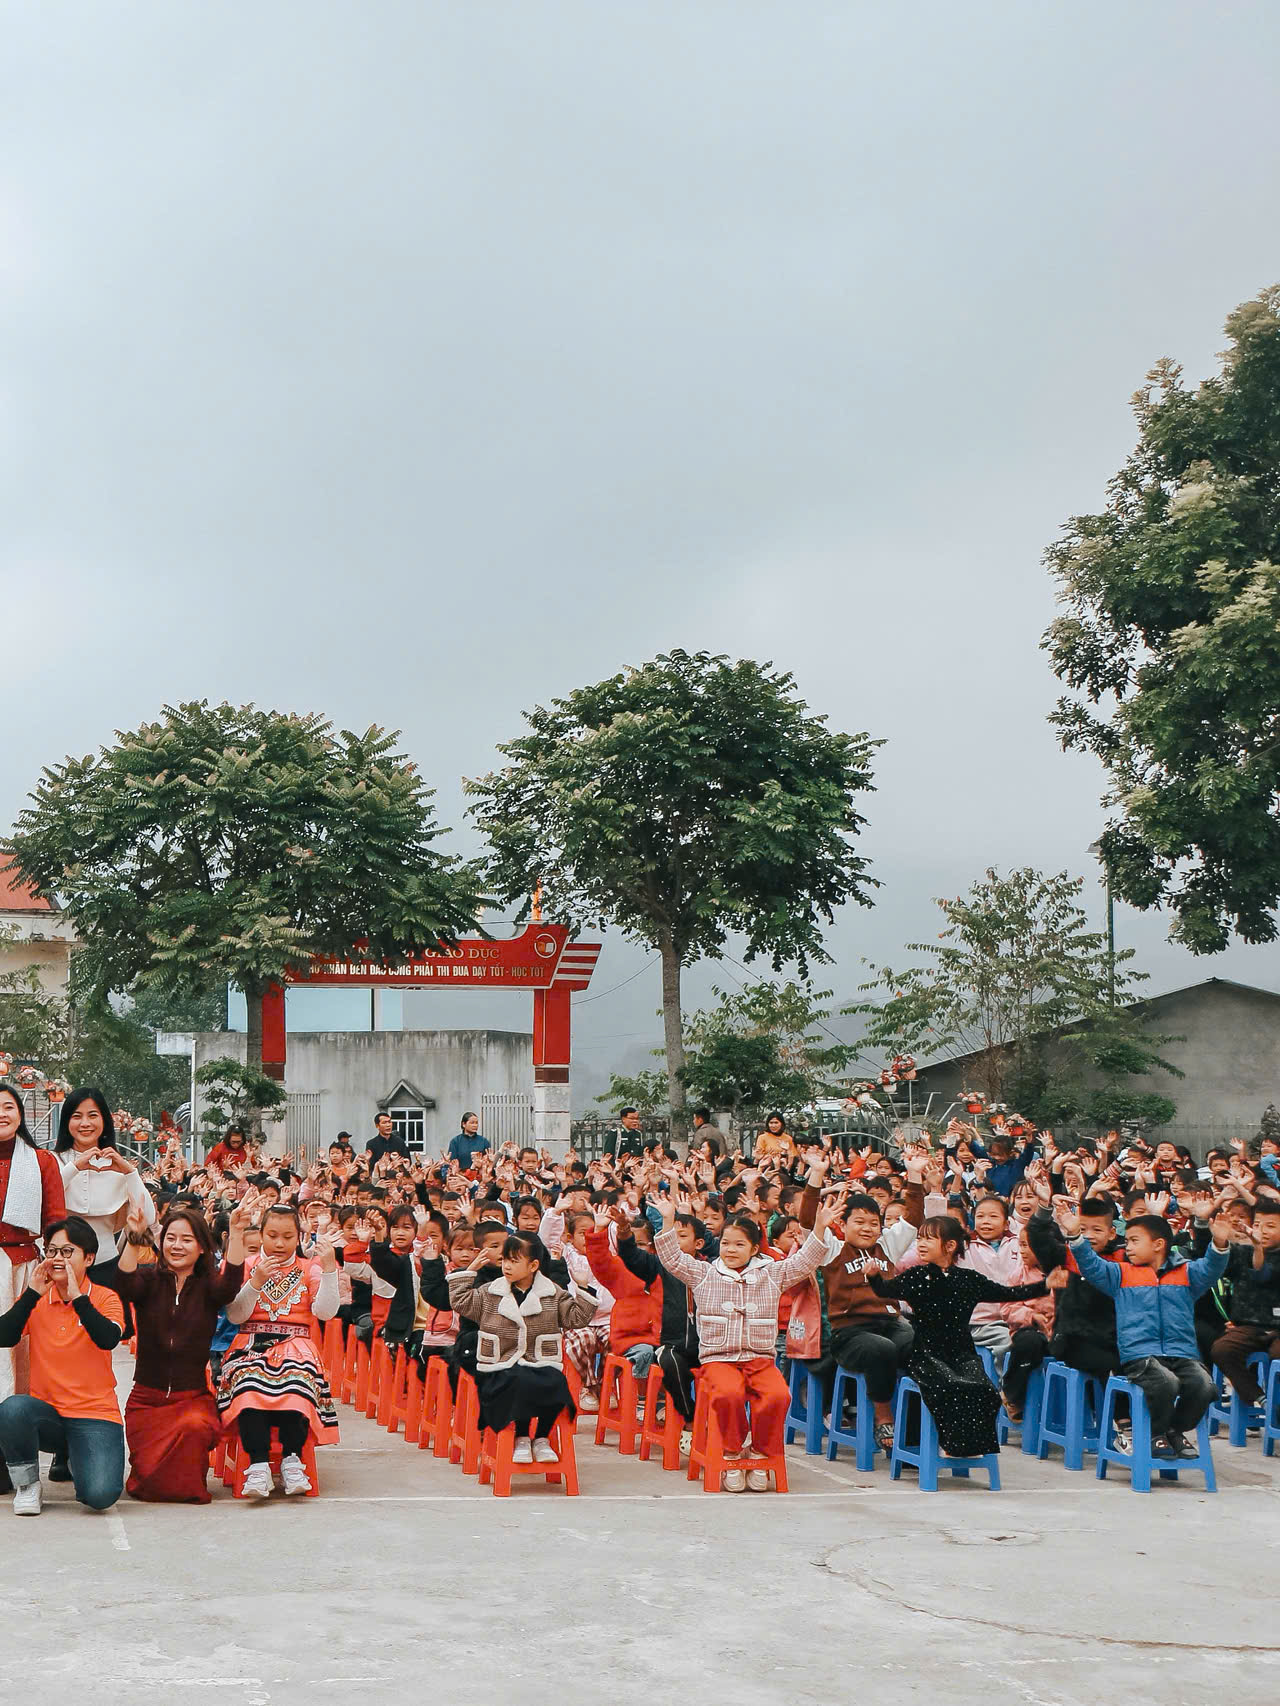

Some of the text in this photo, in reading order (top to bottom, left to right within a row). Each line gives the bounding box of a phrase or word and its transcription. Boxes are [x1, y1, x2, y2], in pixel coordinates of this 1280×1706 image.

[469, 948, 500, 961] DỤC
[413, 961, 433, 976] PHẢI
[437, 965, 450, 977] THI
[453, 965, 470, 977] ĐUA
[472, 966, 487, 979] DẠY
[490, 962, 505, 977] TỐT
[511, 966, 528, 979] HỌC
